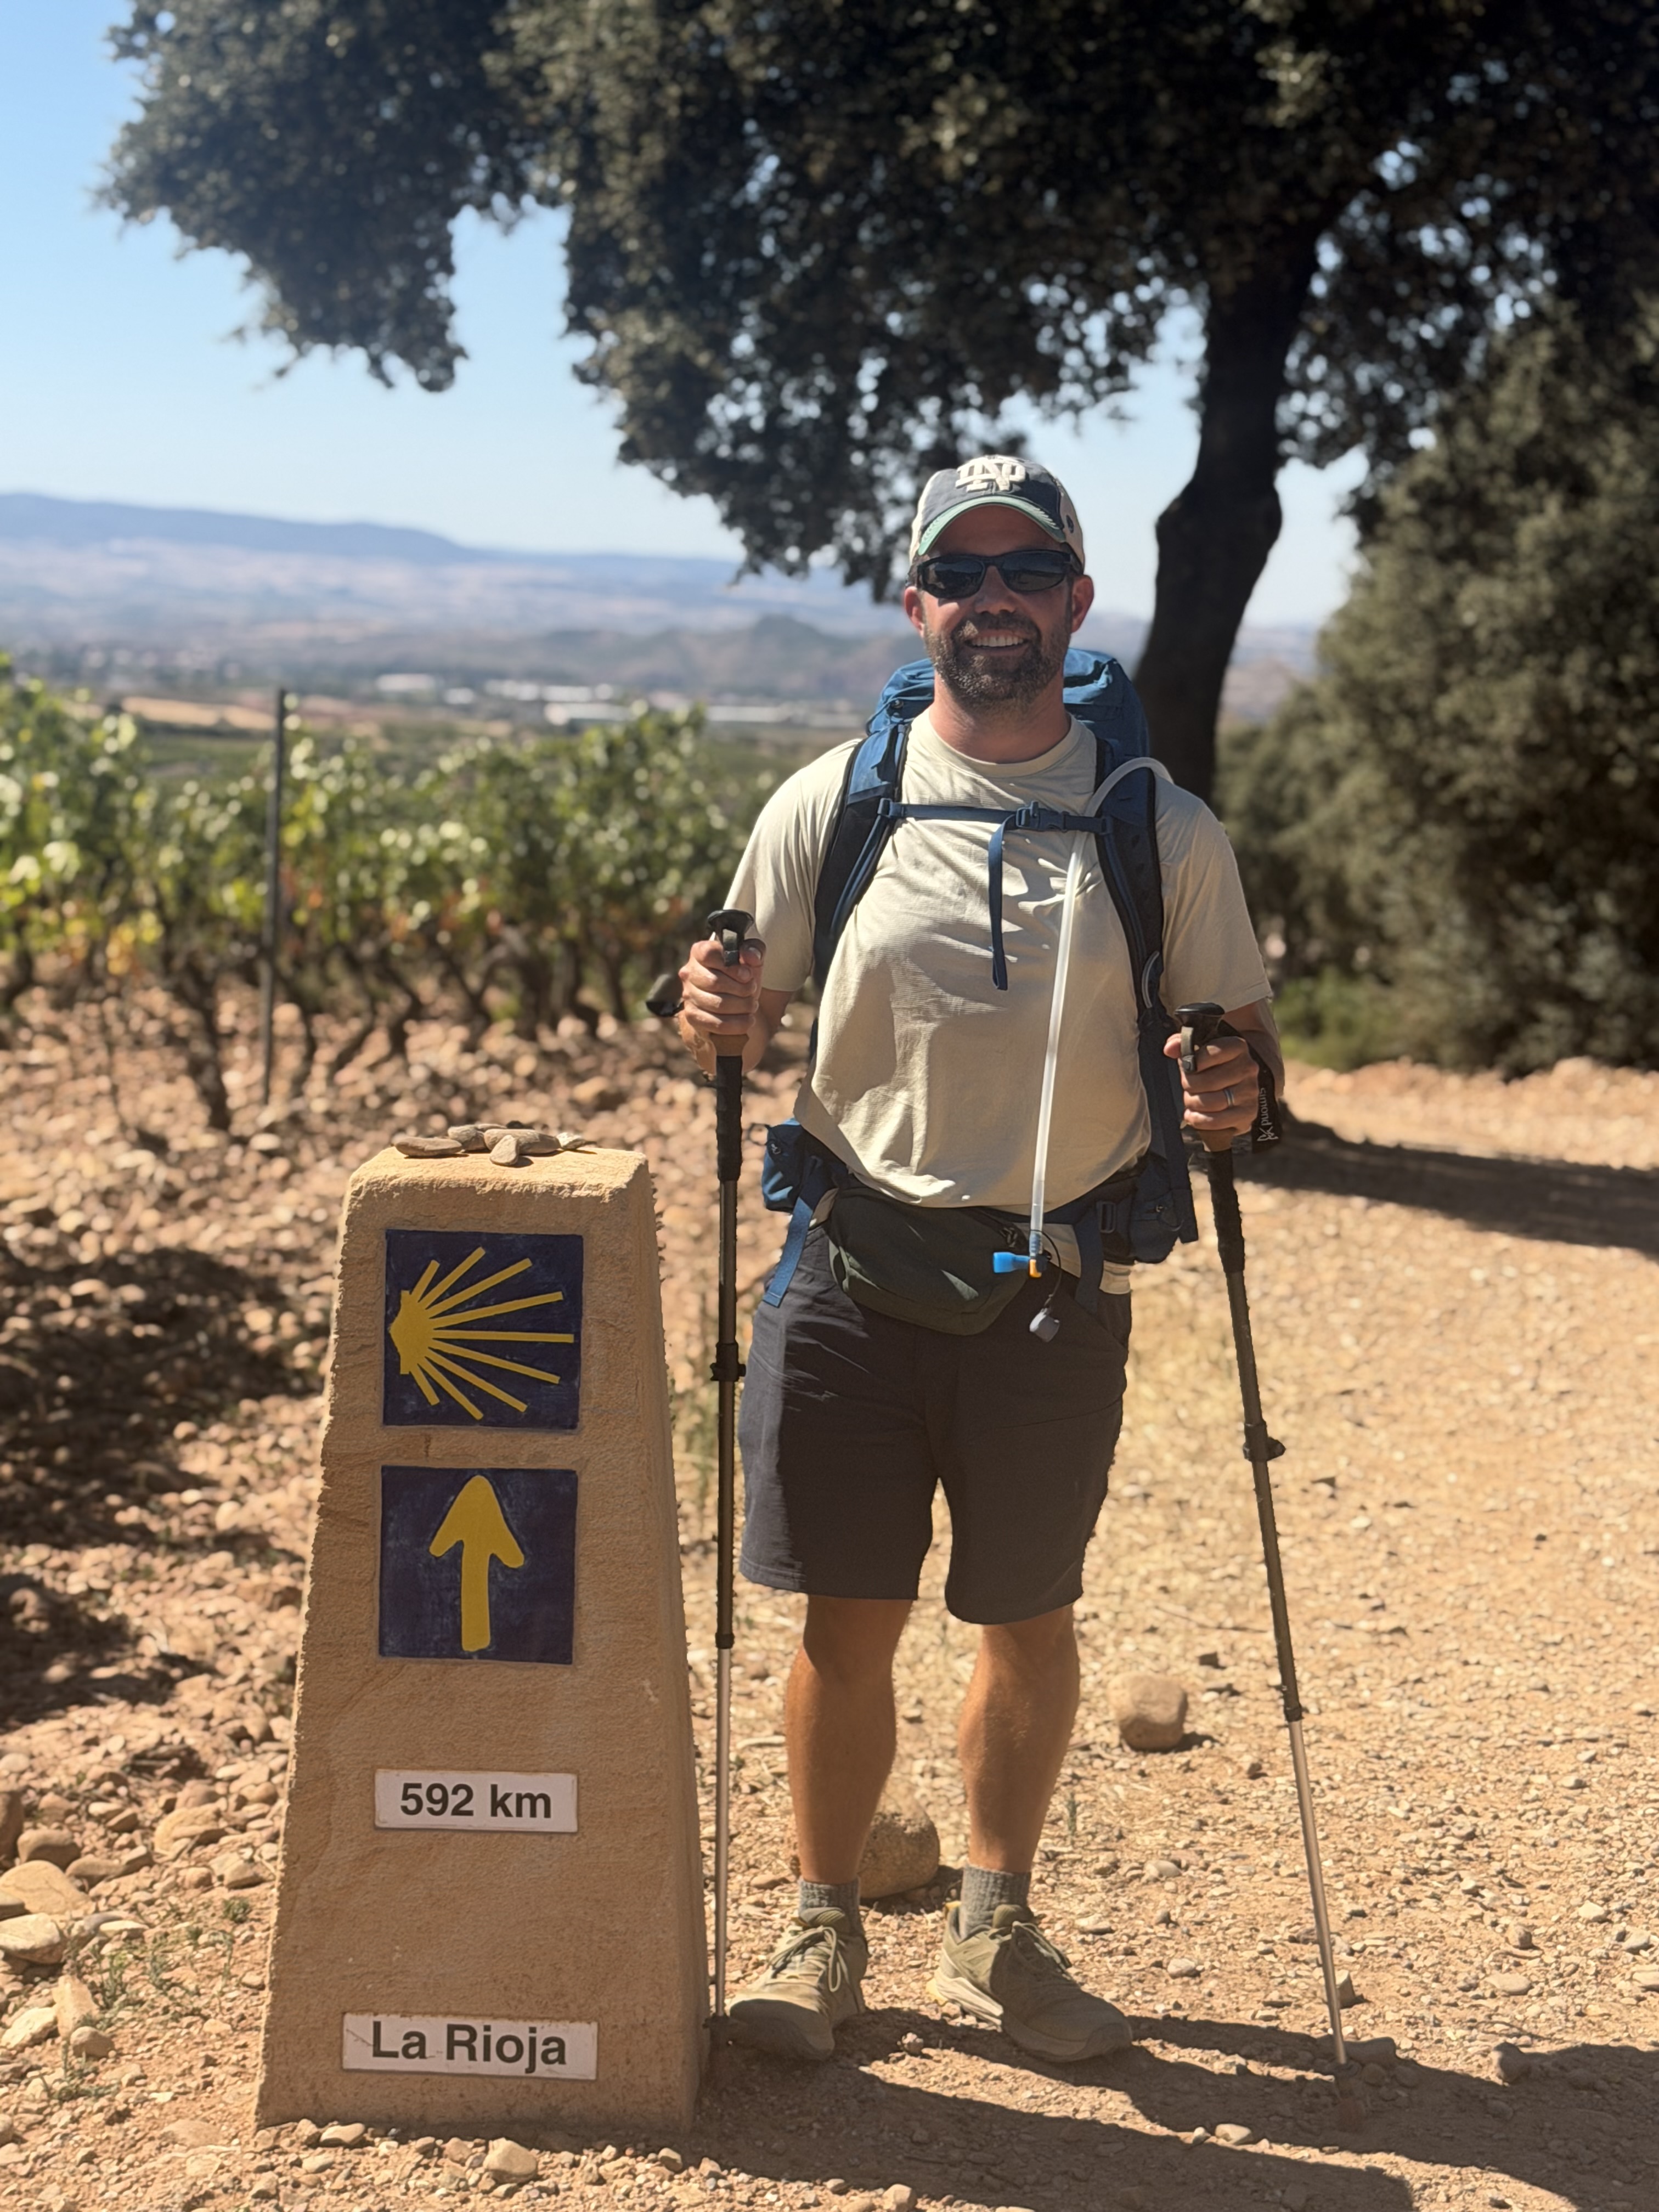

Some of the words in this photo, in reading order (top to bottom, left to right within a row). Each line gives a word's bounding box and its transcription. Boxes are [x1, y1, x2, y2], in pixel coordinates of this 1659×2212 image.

[1260, 1087, 1272, 1126] simond
[400, 1782, 474, 1817] 592
[490, 1784, 551, 1818] km
[372, 2021, 427, 2059] La
[446, 2024, 567, 2074] Rioja
